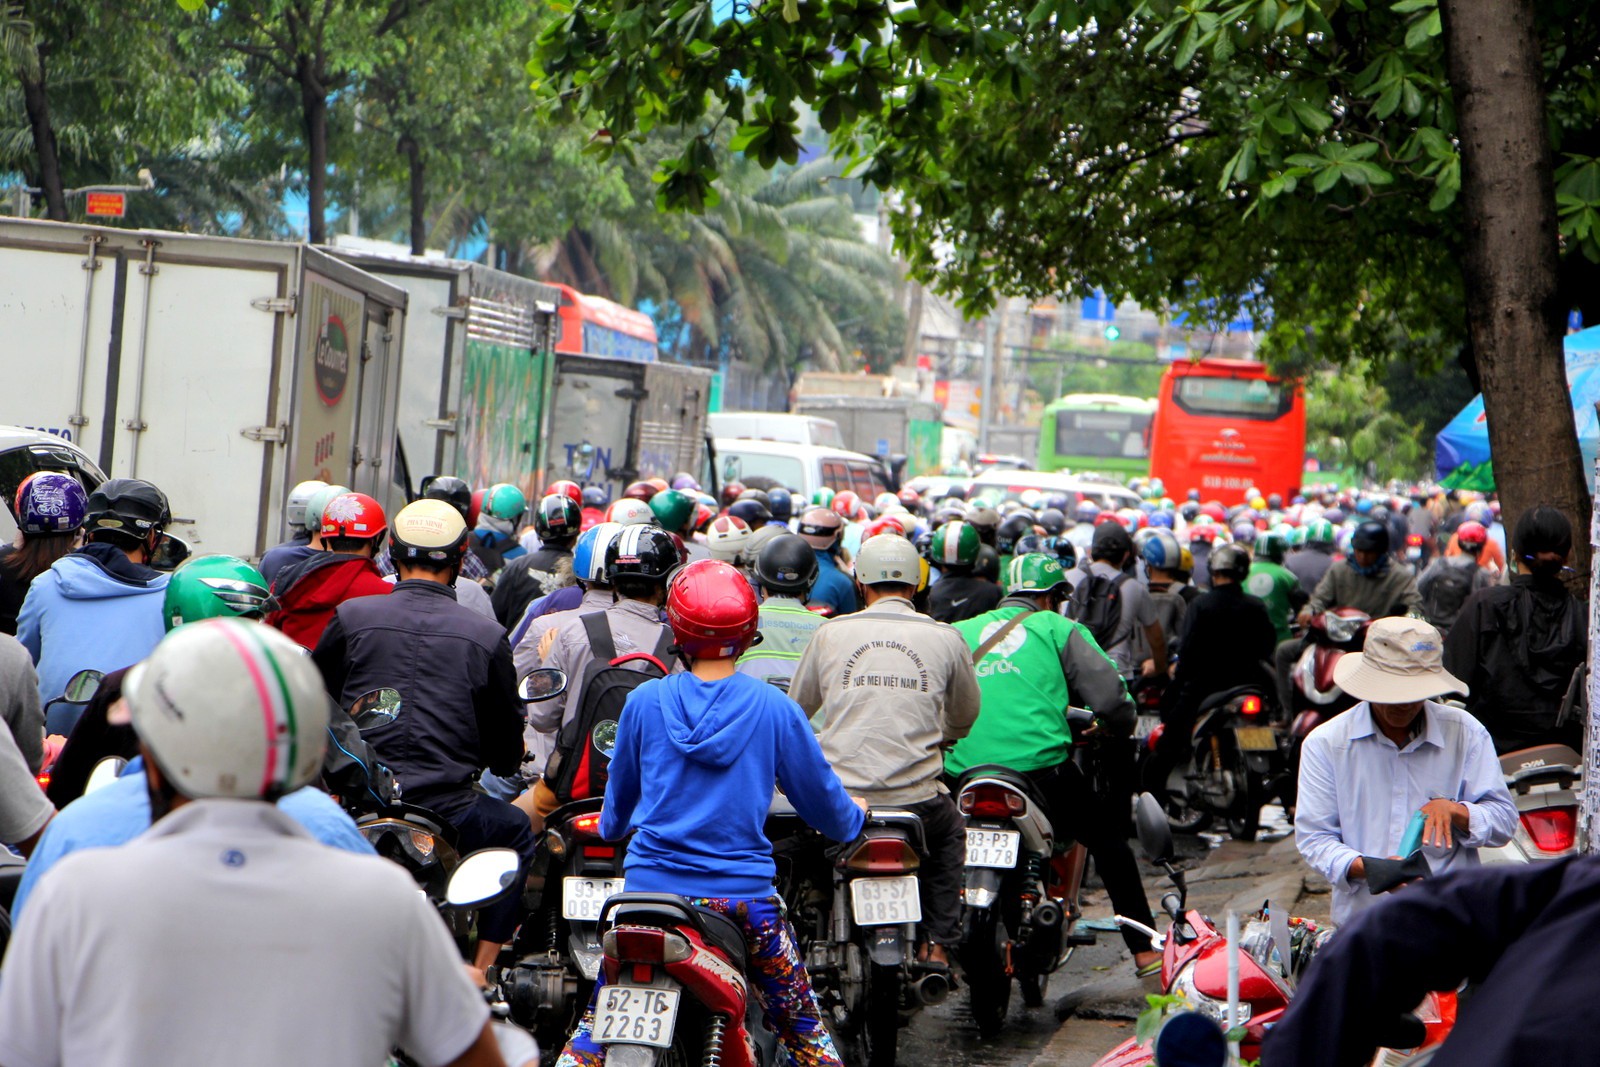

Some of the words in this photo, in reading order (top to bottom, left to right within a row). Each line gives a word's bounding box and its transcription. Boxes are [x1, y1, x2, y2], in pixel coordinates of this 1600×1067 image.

[1044, 561, 1062, 573] Gra
[851, 643, 871, 660] TNHH
[871, 640, 884, 649] THI
[885, 640, 908, 653] CÔNG
[906, 649, 924, 669] CÔNG
[867, 675, 882, 687] MEI
[883, 674, 899, 690] VIỆT
[900, 678, 918, 691] NAM
[864, 900, 910, 920] 8851
[606, 989, 667, 1015] 52-T6
[601, 1014, 662, 1041] 2263
